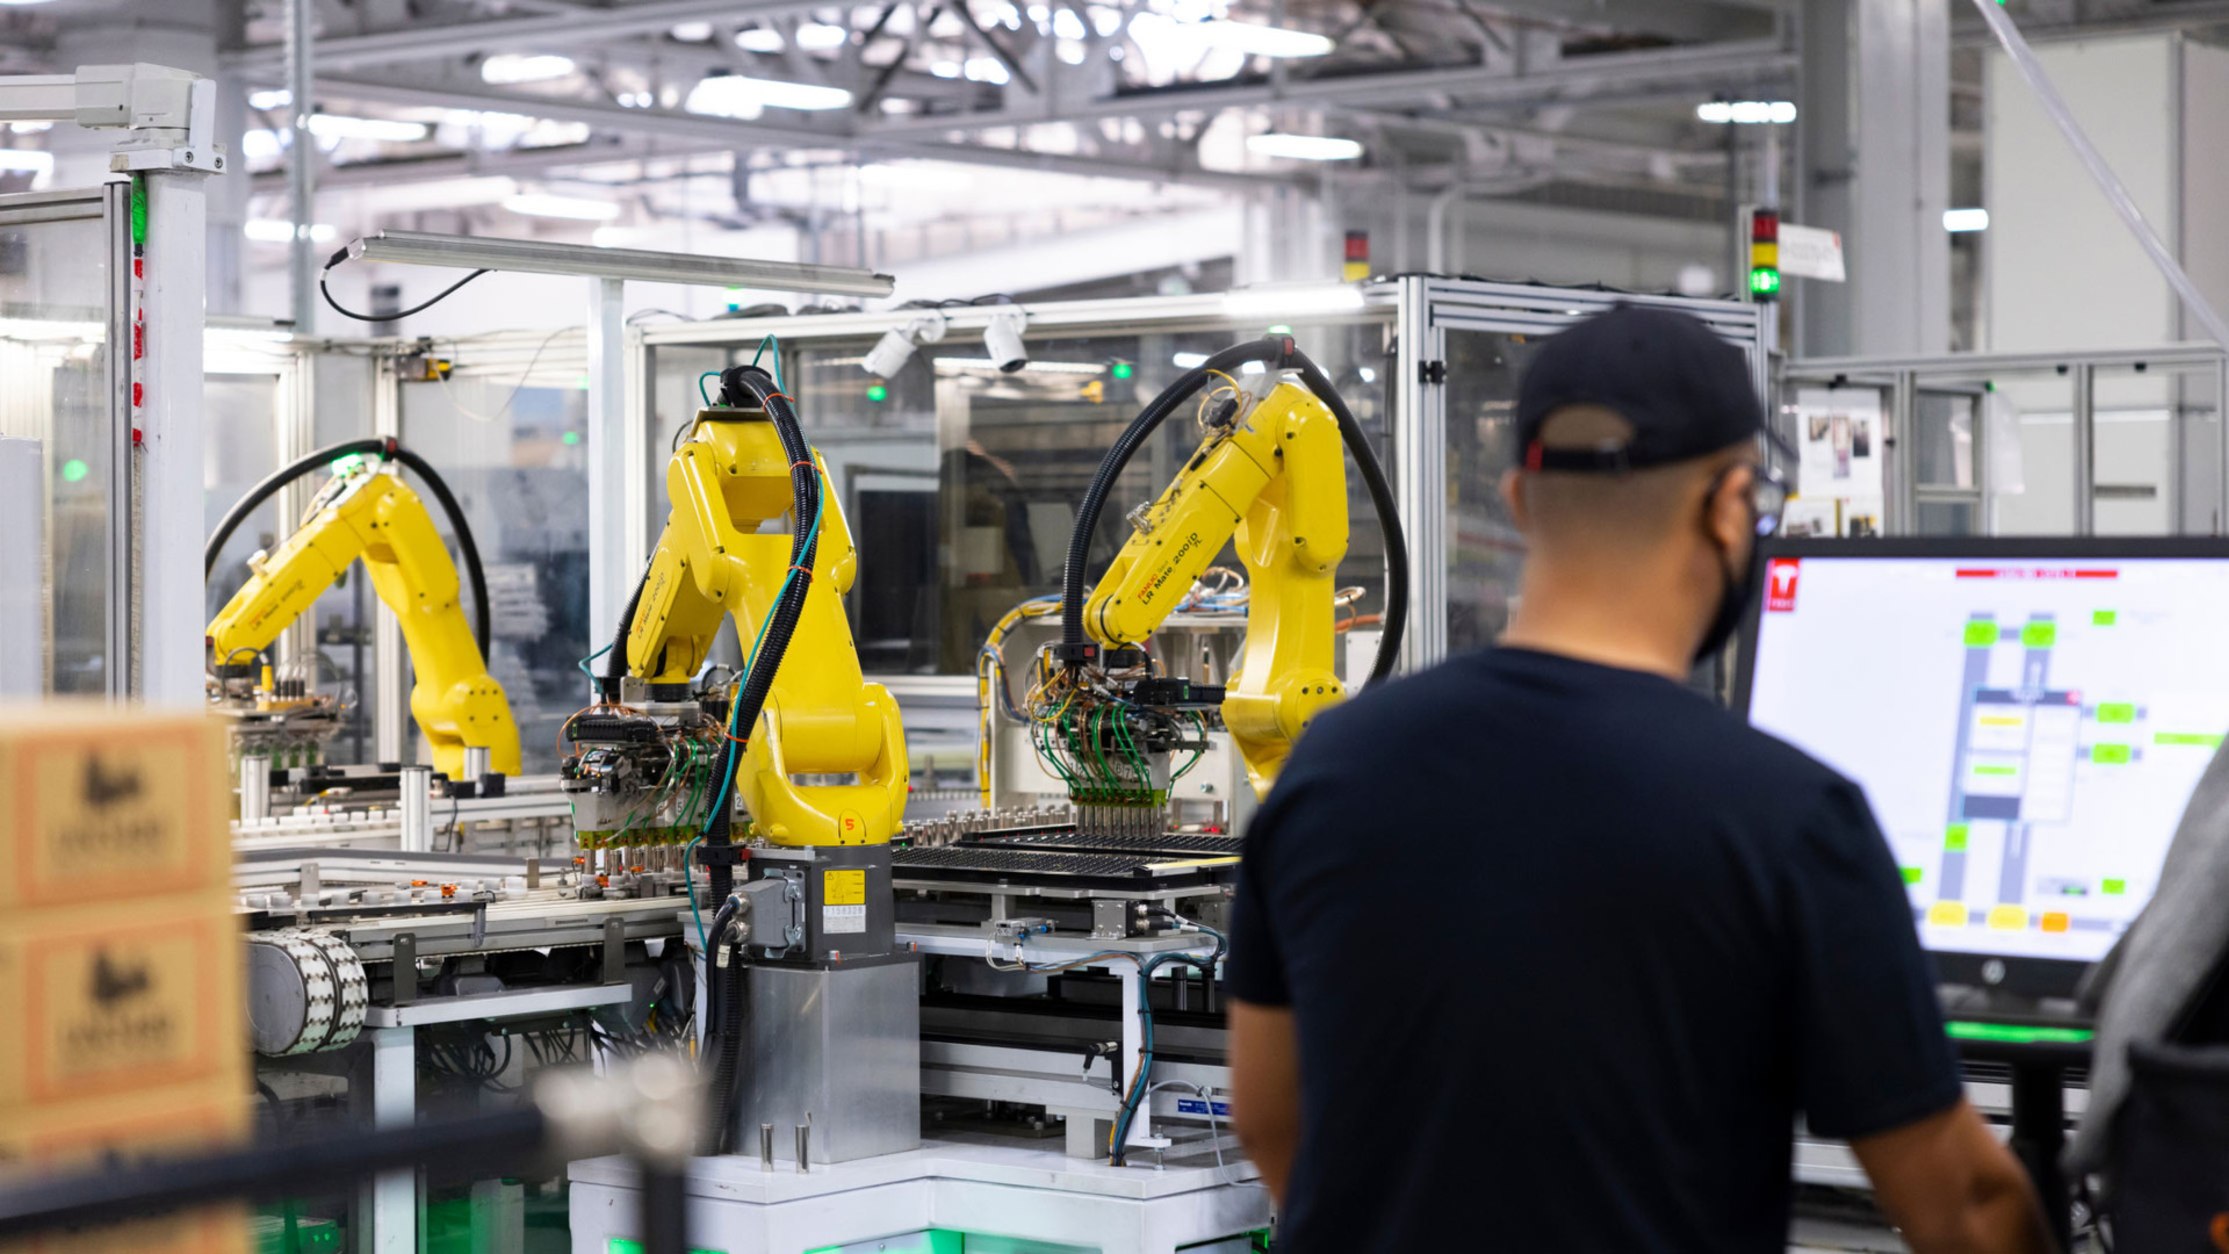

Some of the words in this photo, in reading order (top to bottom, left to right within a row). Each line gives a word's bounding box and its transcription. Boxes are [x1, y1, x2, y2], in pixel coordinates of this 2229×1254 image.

[1137, 573, 1158, 600] FANUC
[1142, 590, 1154, 605] LR
[1154, 566, 1173, 589] Mate
[736, 796, 742, 808] 2
[845, 818, 854, 831] 5
